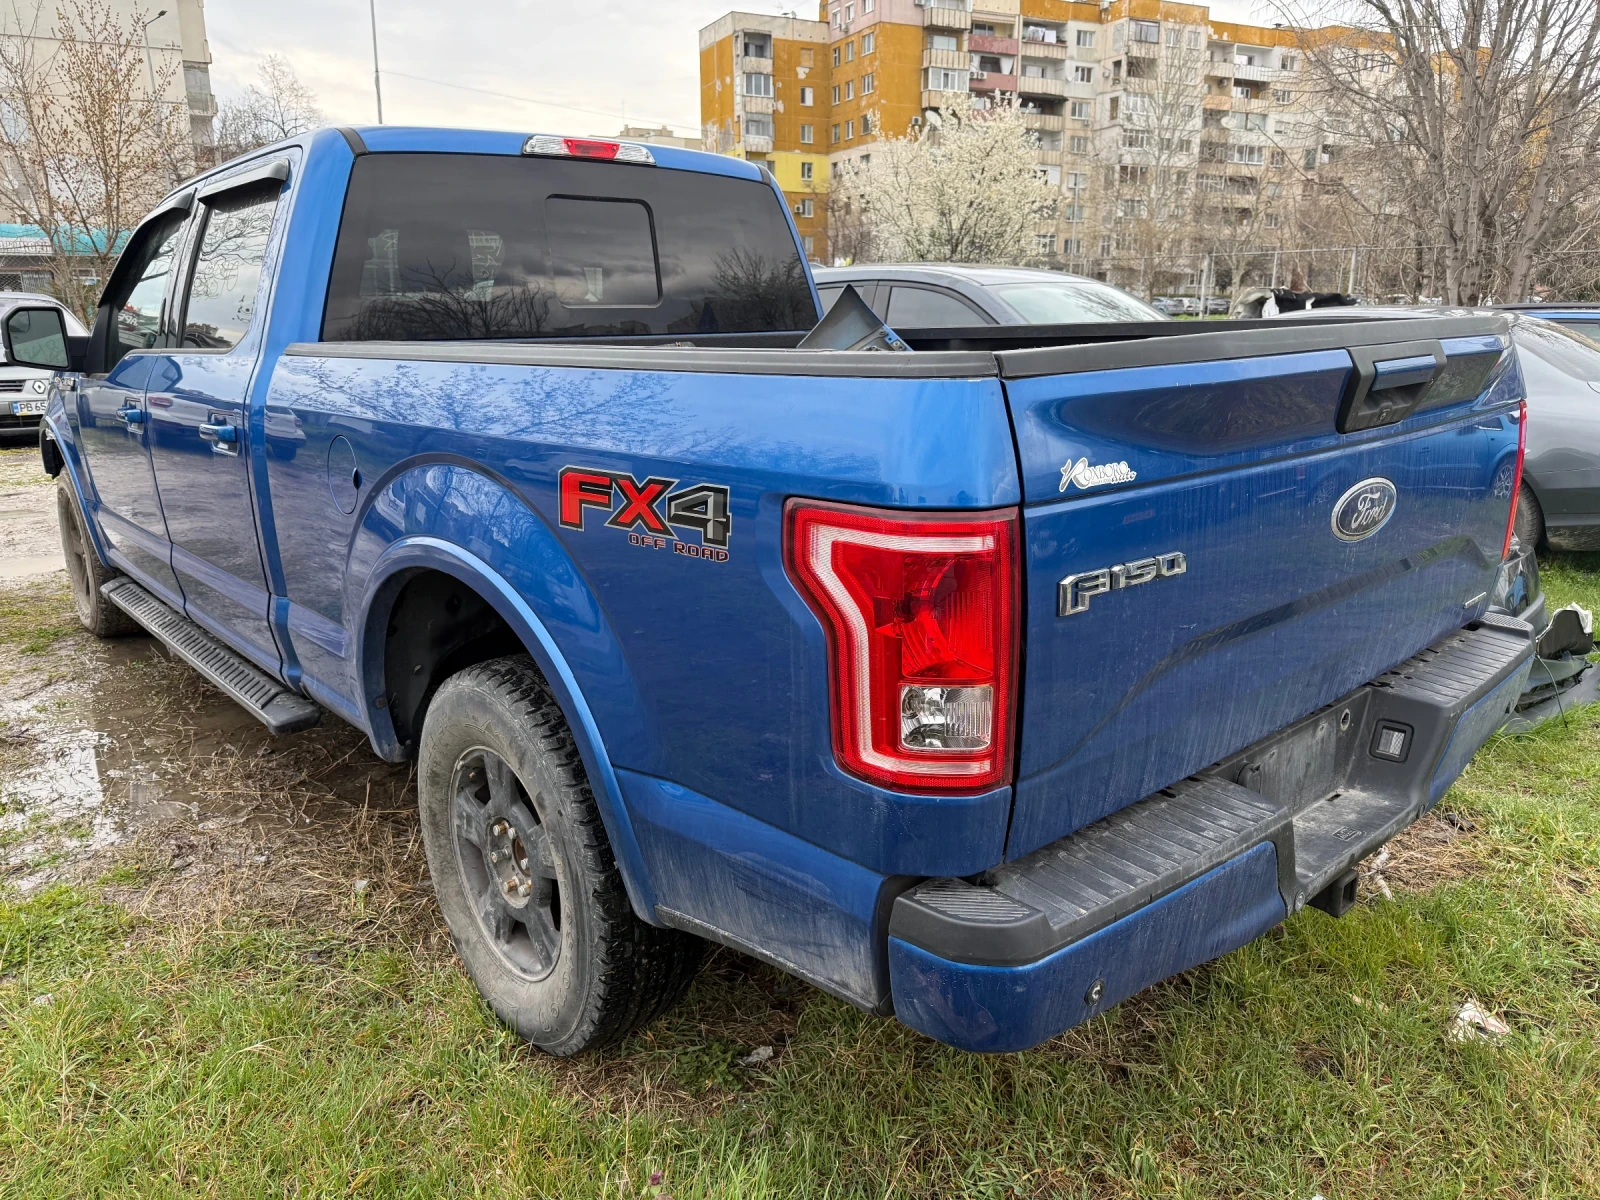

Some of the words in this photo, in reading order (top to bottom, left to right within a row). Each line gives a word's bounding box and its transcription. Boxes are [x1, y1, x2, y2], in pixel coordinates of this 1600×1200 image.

[19, 402, 33, 412] PB
[558, 465, 732, 549] FX4
[628, 532, 666, 549] OFF
[673, 541, 730, 562] ROAD
[1057, 551, 1187, 617] F150
